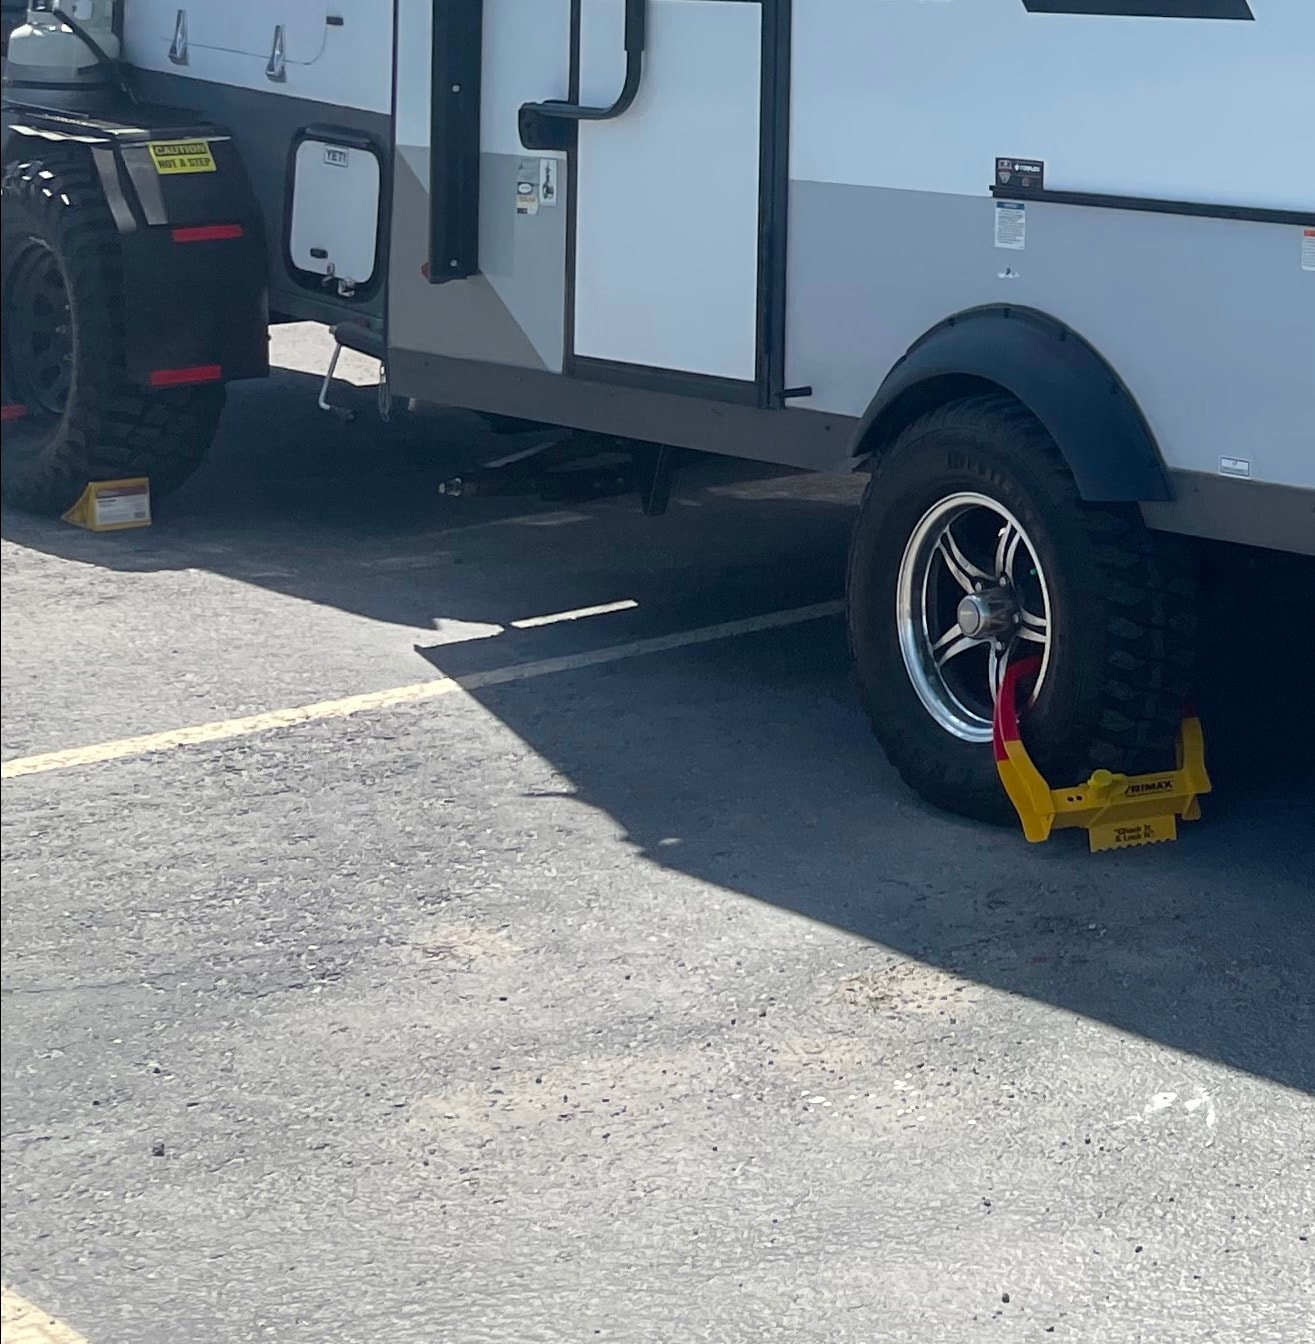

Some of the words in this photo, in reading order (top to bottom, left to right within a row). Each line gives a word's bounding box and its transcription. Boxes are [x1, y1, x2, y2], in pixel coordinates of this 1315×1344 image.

[155, 143, 206, 156] CAUTION
[158, 159, 177, 169] NOT
[188, 157, 211, 168] STEP
